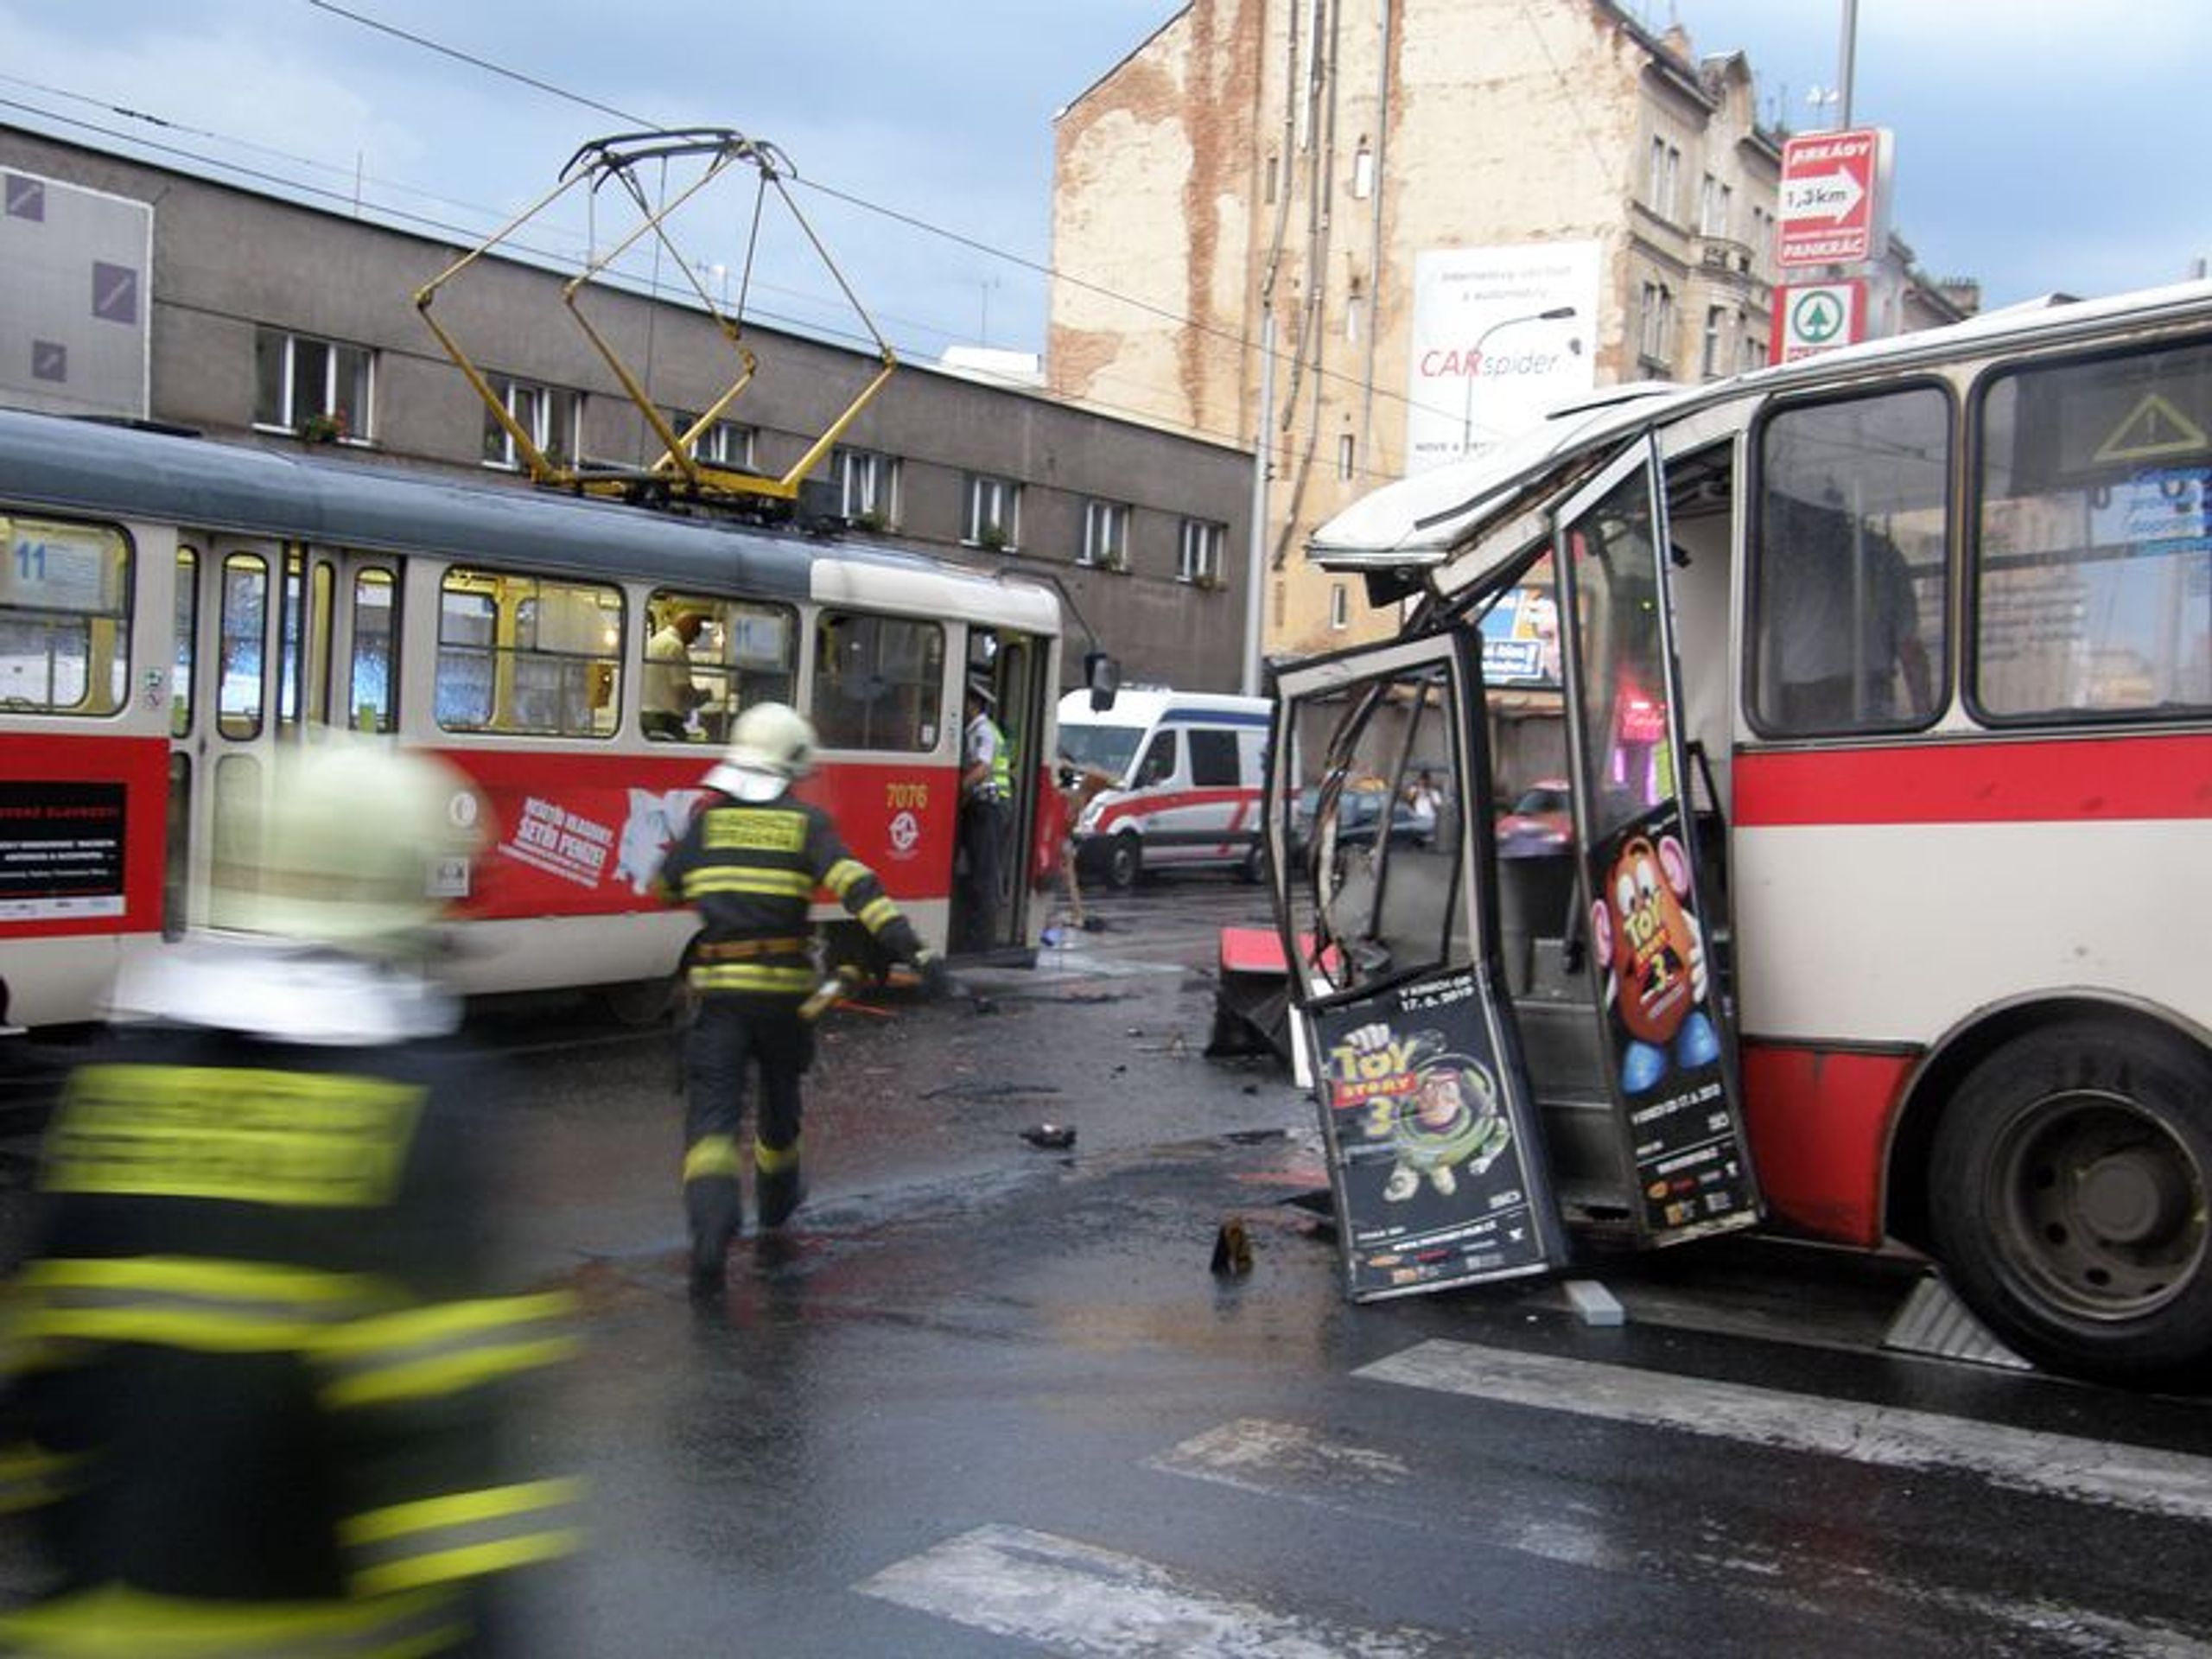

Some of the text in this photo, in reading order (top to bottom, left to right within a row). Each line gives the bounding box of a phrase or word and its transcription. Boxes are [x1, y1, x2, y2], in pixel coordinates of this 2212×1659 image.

[1421, 349, 1560, 379] CARspider
[15, 539, 46, 581] 11
[886, 782, 929, 810] 7076
[1329, 1039, 1420, 1084] TOY
[1341, 1076, 1411, 1097] STORY
[1364, 1096, 1395, 1137] 3
